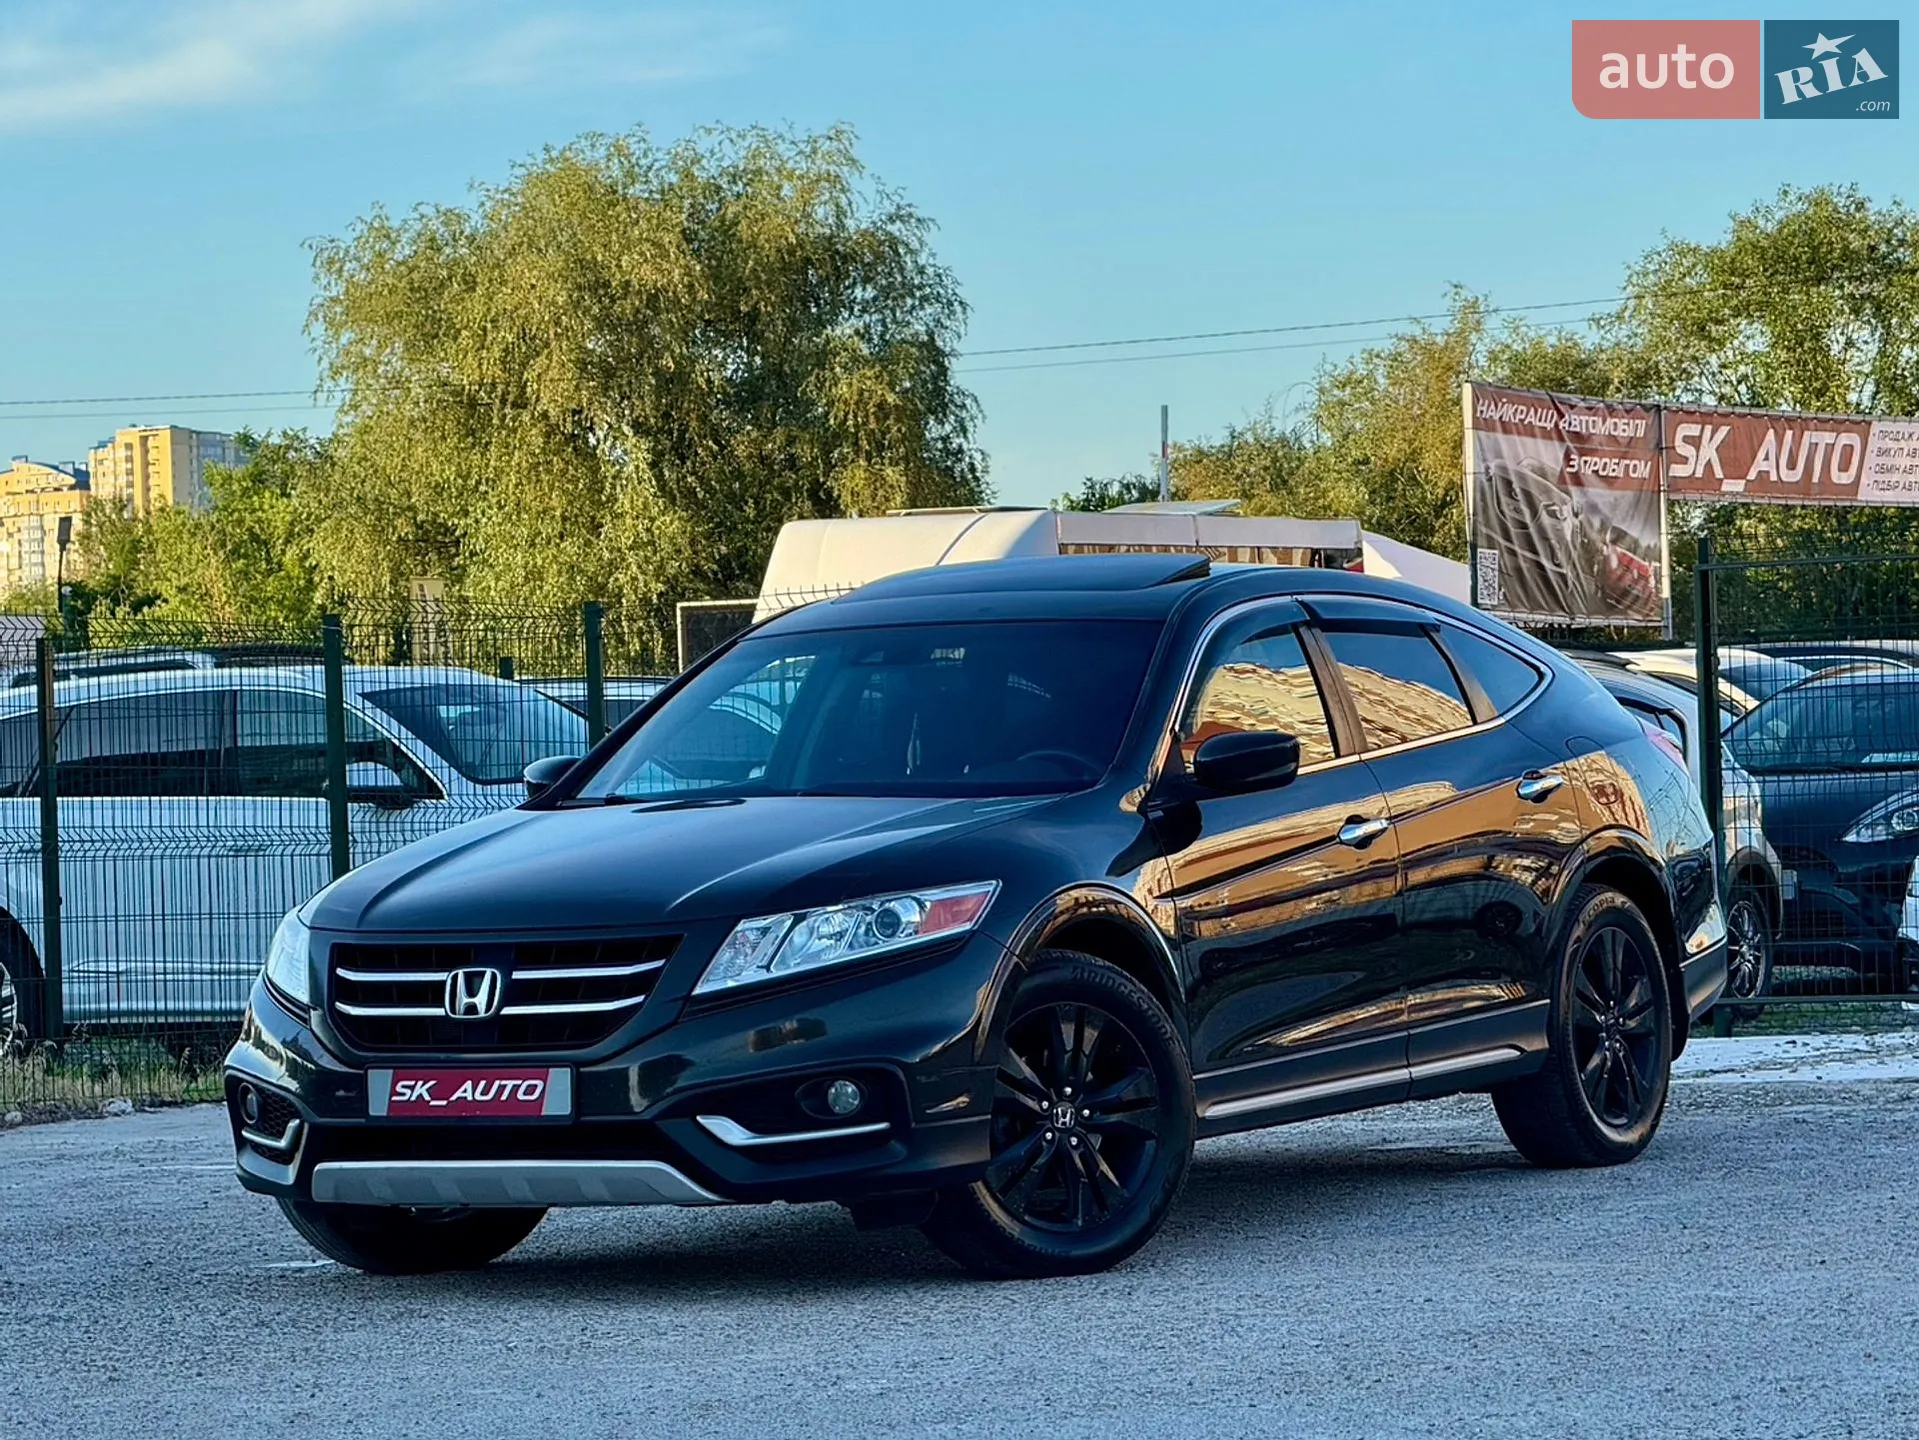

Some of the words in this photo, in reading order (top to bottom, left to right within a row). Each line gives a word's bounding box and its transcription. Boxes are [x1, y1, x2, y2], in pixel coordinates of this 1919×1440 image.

[1477, 398, 1557, 431] НАЙКРАЩІ
[1559, 413, 1647, 438] АВТОМОБІЛІ
[1877, 430, 1914, 442] ПРОДАЖ
[1668, 422, 1862, 492] SK_AUTO
[1876, 447, 1904, 459] ВИКУП
[1905, 447, 1919, 459] АВ
[1580, 456, 1652, 478] ПРОБІГОМ
[1874, 463, 1900, 475] ОБМІН
[1871, 480, 1900, 492] ПІДБІР
[1901, 480, 1919, 492] АВТ
[1071, 964, 1176, 1049] BRIDGESTONE
[391, 1080, 545, 1106] SK_AUTO
